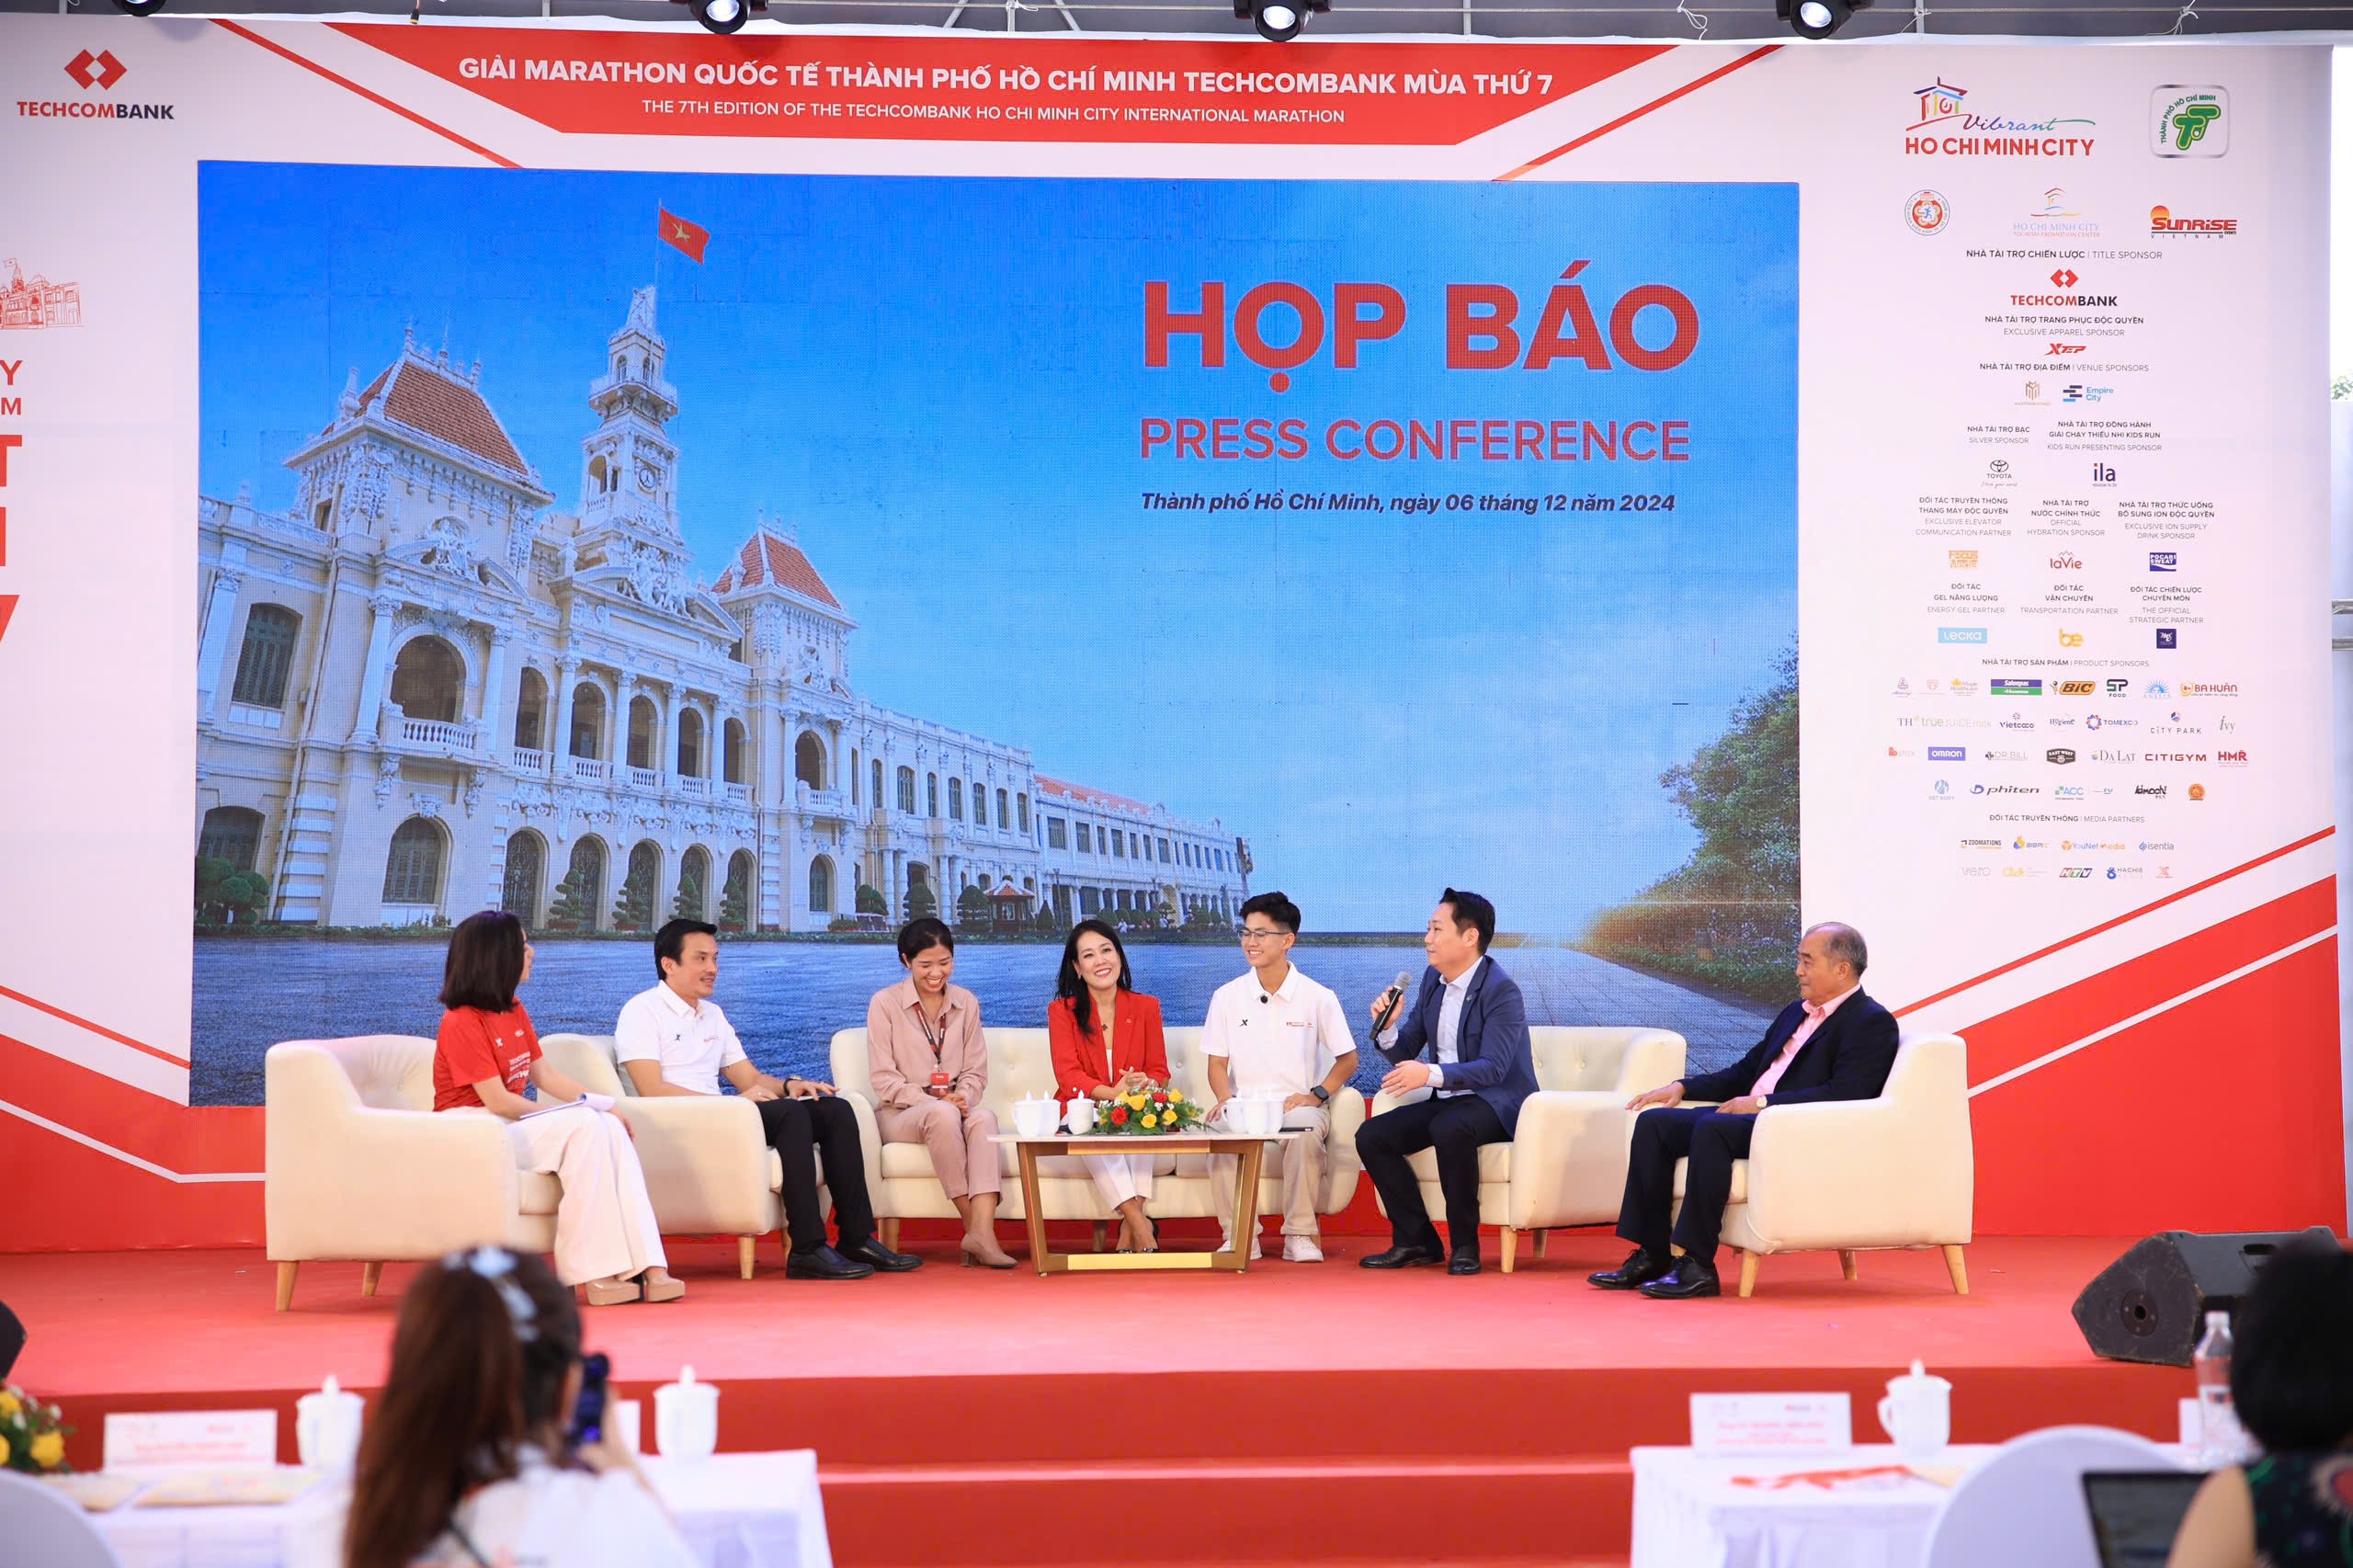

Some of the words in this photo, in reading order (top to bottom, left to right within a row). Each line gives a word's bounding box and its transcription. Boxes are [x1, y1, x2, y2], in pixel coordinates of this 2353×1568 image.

[459, 54, 515, 79] GIẢI
[525, 60, 686, 83] MARATHON
[694, 60, 778, 85] QUỐC
[786, 61, 820, 86] TẾ
[826, 62, 923, 88] THÀNH
[932, 63, 992, 89] PHỐ
[999, 64, 1040, 90] HỒ
[1048, 65, 1097, 90] CHÍ
[1104, 71, 1176, 91] MINH
[1184, 72, 1396, 94] TECHCOMBANK
[1404, 69, 1466, 94] MÙA
[1473, 69, 1532, 95] THỨ
[1537, 74, 1552, 95] 7
[17, 101, 175, 119] TECHCOMBANK
[642, 100, 673, 114] THE
[679, 100, 709, 114] 7TH
[714, 101, 779, 115] EDITION
[784, 102, 805, 115] OF
[810, 103, 841, 116] THE
[847, 104, 972, 119] TECHCOMBANK
[977, 106, 1001, 119] HO
[1005, 106, 1033, 120] CHI
[1038, 107, 1079, 120] MINH
[1084, 108, 1118, 120] CITY
[1124, 108, 1249, 122] INTERNATIONAL
[1254, 109, 1345, 122] MARATHON
[1962, 114, 2064, 131] Vibrant
[1906, 138, 1938, 155] HO
[1943, 138, 1979, 155] CHI
[1984, 138, 2038, 155] MINH
[2039, 138, 2095, 156] CITY
[2014, 222, 2028, 231] HO
[2030, 222, 2046, 231] CHI
[1990, 250, 2003, 258] TÀI
[2011, 295, 2118, 306] TECHCOMBANK
[1144, 281, 1406, 392] HỌP
[1446, 260, 1699, 371] BÁO
[2086, 394, 2101, 402] City
[1142, 418, 1308, 459] PRESS
[1326, 419, 1689, 461] CONFERENCE
[2094, 463, 2116, 481] ila
[1142, 492, 1205, 511] Thành
[1209, 488, 1251, 513] phố
[1255, 488, 1284, 511] Hồ
[1290, 492, 1324, 511] Chí
[1328, 493, 1385, 513] Minh,
[1390, 493, 1440, 516] ngày
[1445, 494, 1474, 512] 06
[1479, 493, 1538, 516] tháng
[1544, 495, 1566, 512] 12
[1571, 494, 1614, 512] năm
[1620, 494, 1676, 513] 2024
[2050, 557, 2082, 569] laVie
[2059, 628, 2084, 647] be
[2195, 684, 2208, 693] BA
[2210, 682, 2237, 693] HUÂN
[1897, 718, 1912, 726] TH
[1922, 717, 1943, 727] true
[1987, 786, 2039, 795] phiten
[2060, 868, 2092, 878] HTV
